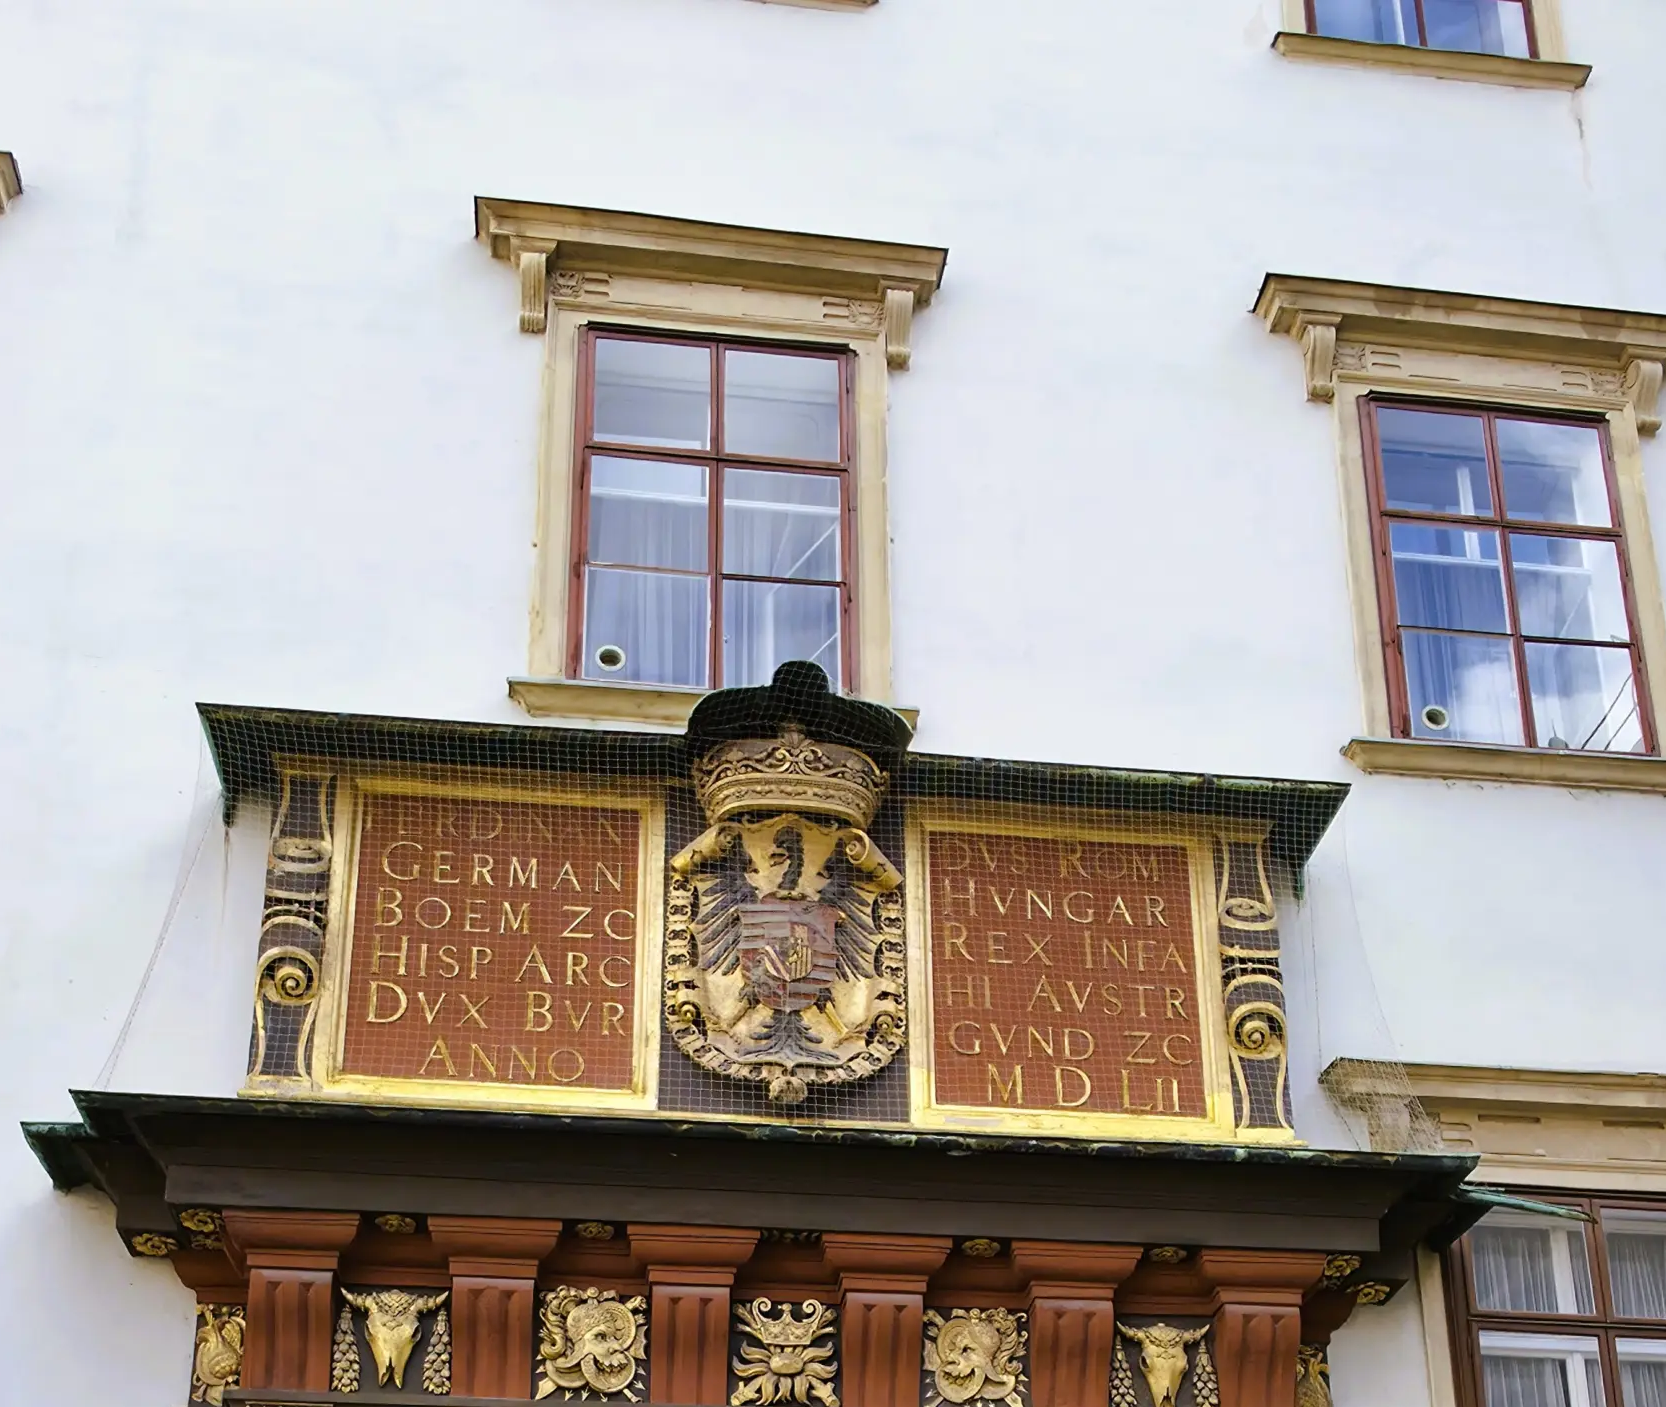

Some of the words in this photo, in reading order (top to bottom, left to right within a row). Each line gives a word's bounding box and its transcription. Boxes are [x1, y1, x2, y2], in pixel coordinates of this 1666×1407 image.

[382, 841, 623, 893] GERMAN
[1058, 844, 1161, 883] ROM
[375, 887, 532, 935] BOEM
[943, 877, 1171, 929] HVNGAR
[370, 934, 495, 981] HISP
[514, 943, 632, 988] ARC
[943, 922, 1055, 967] REX
[1084, 929, 1189, 974] INFA
[366, 980, 491, 1029] DVX
[525, 990, 627, 1037] BVR
[1027, 974, 1189, 1021] AVSTR
[418, 1037, 586, 1084] ANNO
[948, 1020, 1096, 1062] GVND
